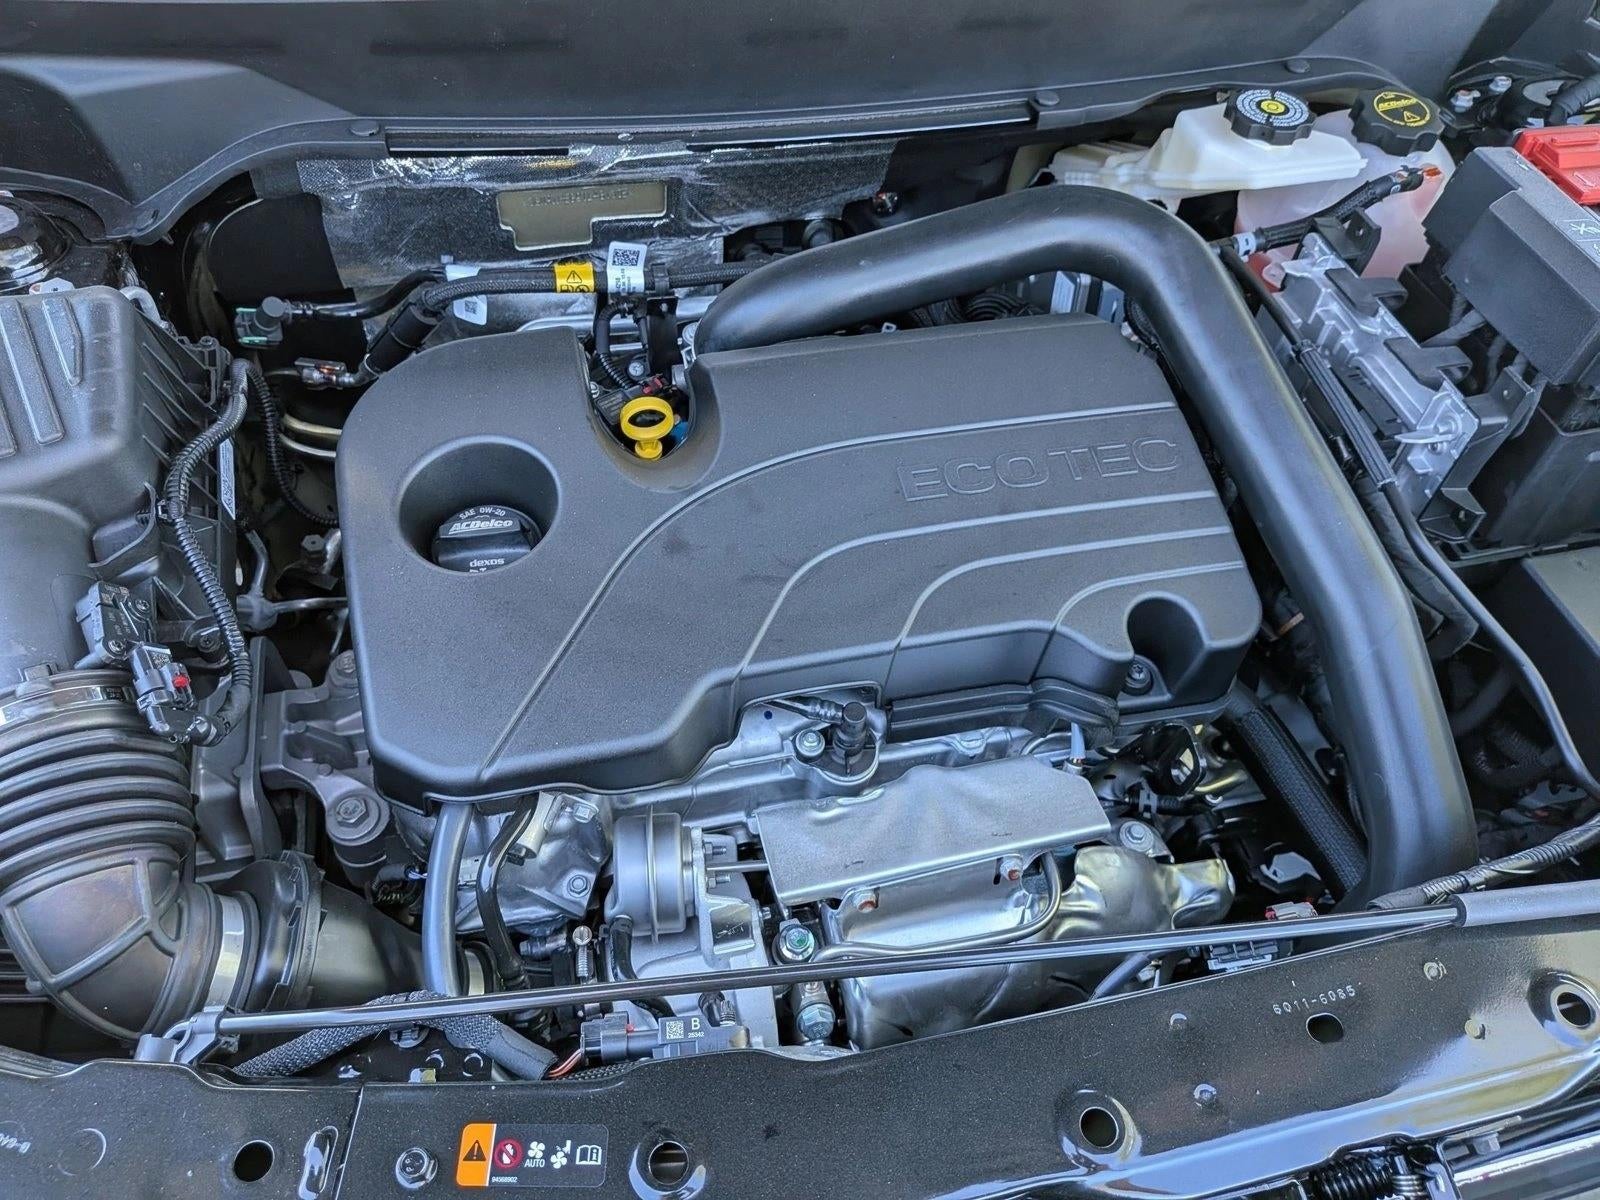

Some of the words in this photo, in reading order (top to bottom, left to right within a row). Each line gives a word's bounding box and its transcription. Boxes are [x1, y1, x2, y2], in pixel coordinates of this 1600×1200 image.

[897, 437, 1177, 502] ECOTEC
[459, 508, 477, 520] SAE
[479, 506, 506, 517] 0W-20
[448, 519, 514, 534] ACDelco
[469, 558, 505, 568] dexos
[1272, 984, 1356, 1015] 6011-6085
[691, 1017, 700, 1030] B
[524, 1158, 546, 1168] AUTO
